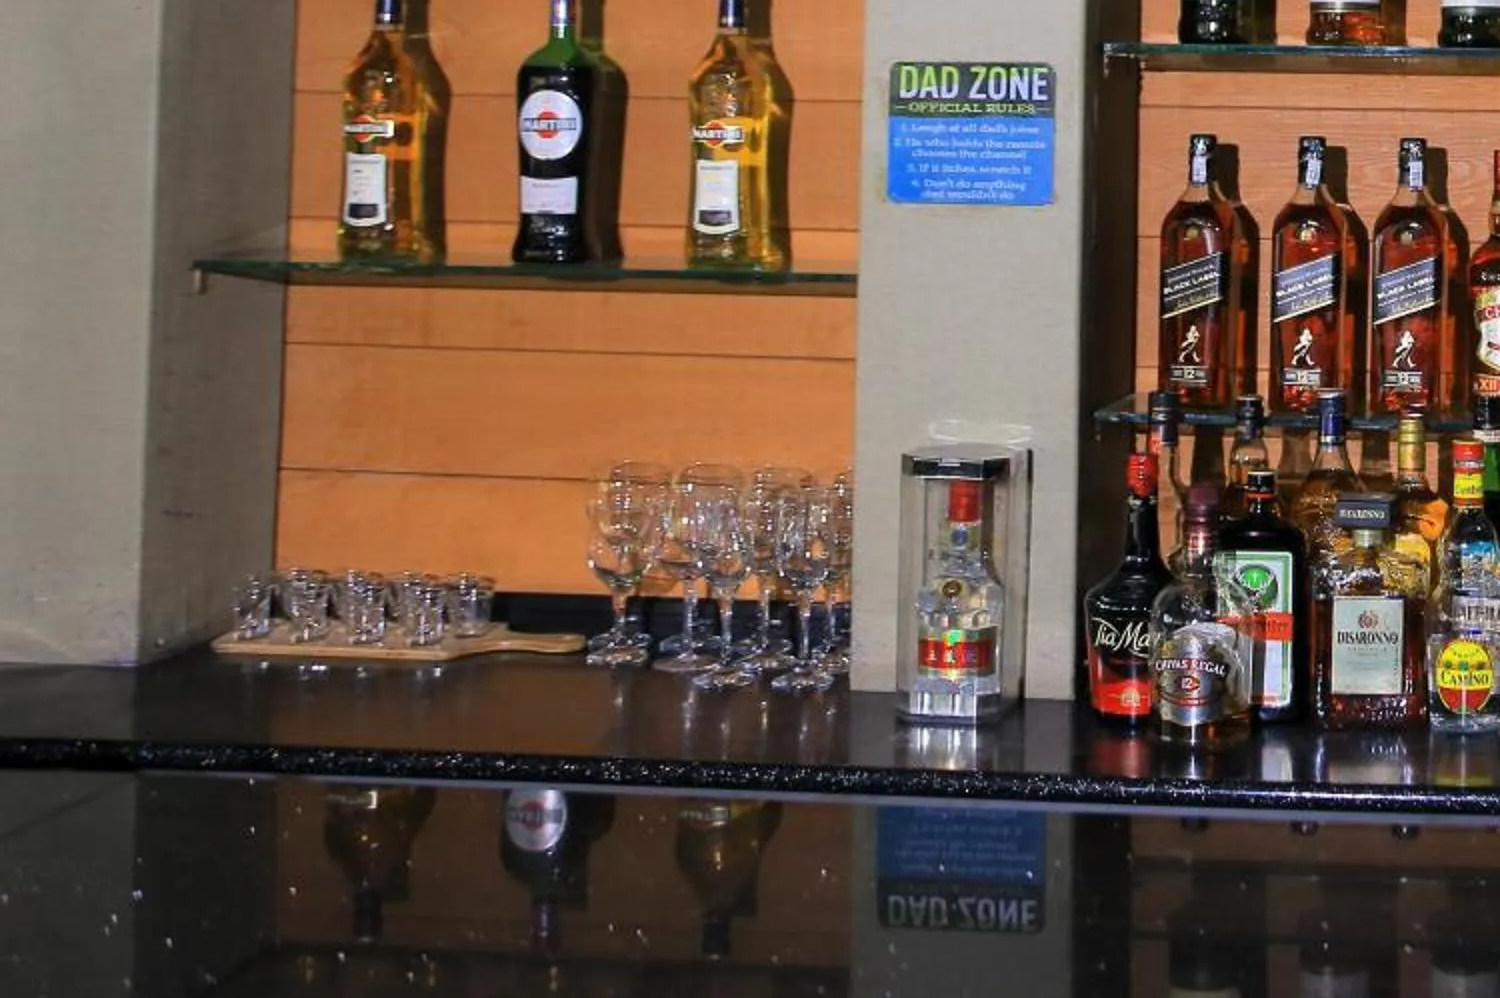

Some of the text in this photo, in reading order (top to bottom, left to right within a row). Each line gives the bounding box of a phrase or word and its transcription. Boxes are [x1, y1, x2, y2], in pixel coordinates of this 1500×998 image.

[899, 64, 1050, 101] DAD ZONE
[908, 102, 1036, 114] OFFICIAL RULES
[1091, 616, 1120, 647] Tia
[1337, 630, 1399, 645] DISARONNO
